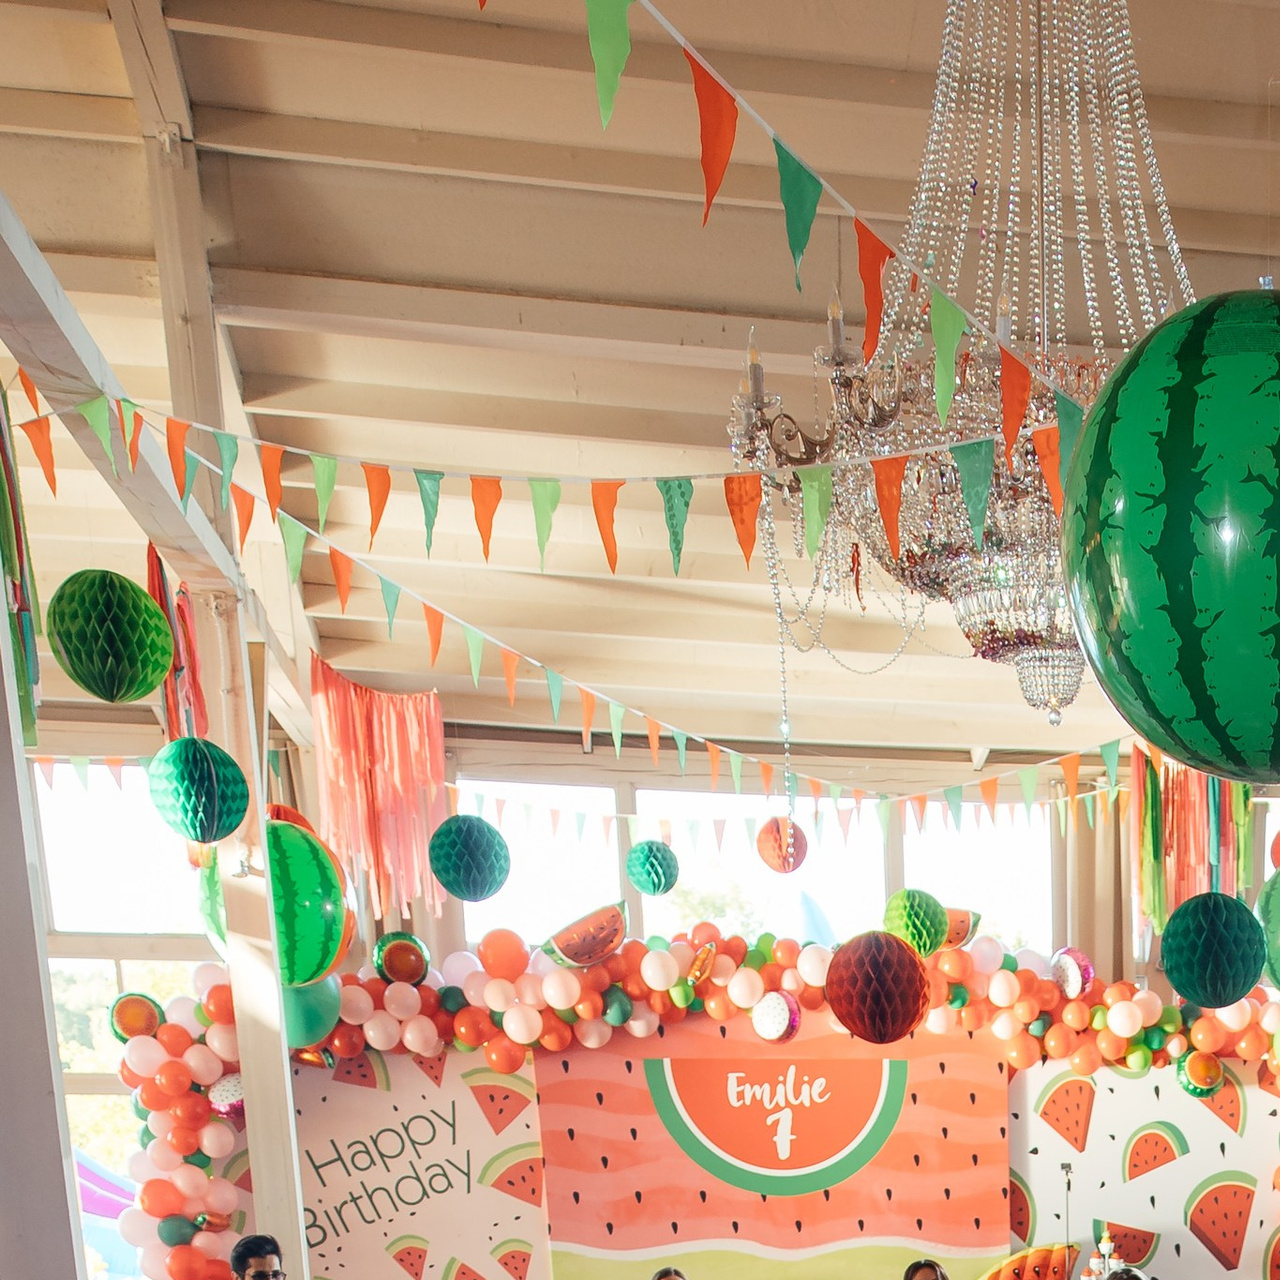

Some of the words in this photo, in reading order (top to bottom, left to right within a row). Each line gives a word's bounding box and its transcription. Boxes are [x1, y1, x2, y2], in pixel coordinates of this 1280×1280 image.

[727, 1064, 831, 1110] Emilie
[305, 1100, 457, 1188] Happy
[766, 1107, 797, 1161] 7
[304, 1149, 471, 1250] Birthday
